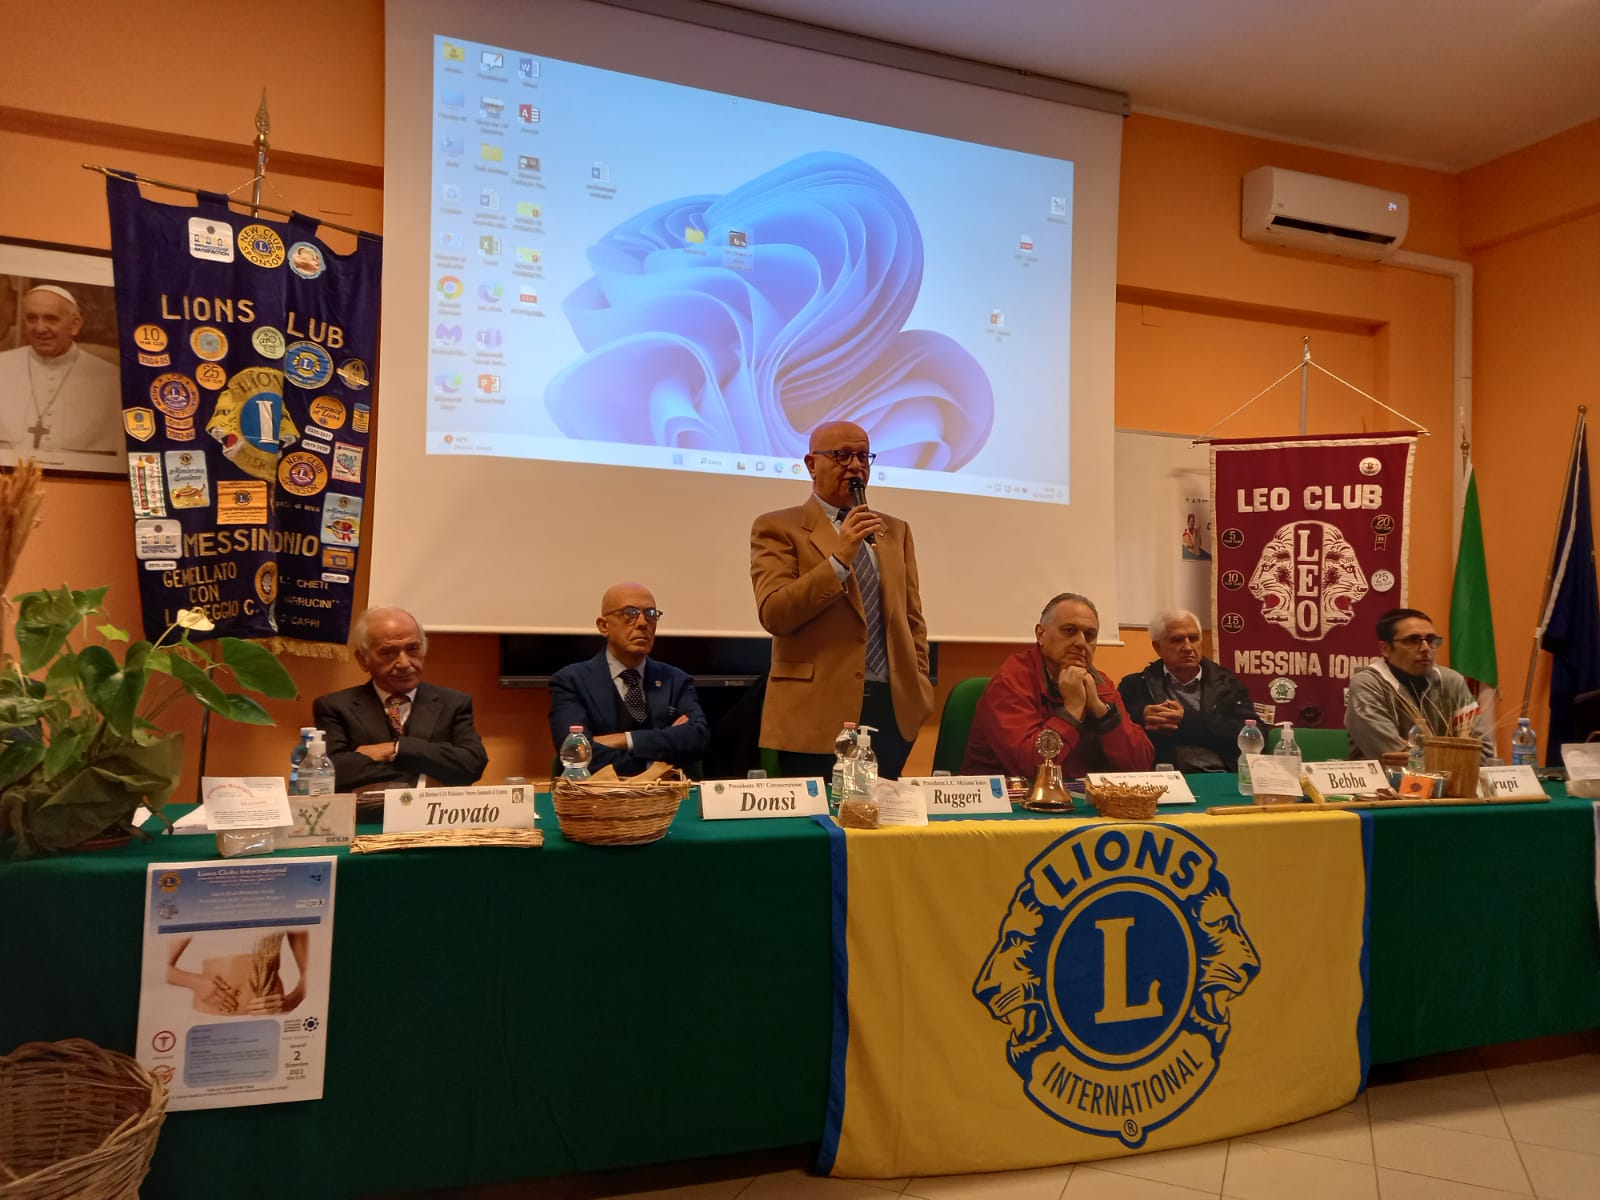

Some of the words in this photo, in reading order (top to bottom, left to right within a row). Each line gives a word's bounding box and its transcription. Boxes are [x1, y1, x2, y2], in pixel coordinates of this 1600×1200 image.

[240, 227, 258, 242] NEW
[263, 229, 283, 251] CLUB
[241, 246, 282, 266] SPONSOR
[161, 294, 256, 323] LIONS
[143, 327, 160, 341] 10
[203, 365, 219, 379] 25
[286, 455, 303, 465] NEW
[307, 456, 324, 474] CLUB
[1236, 487, 1291, 513] LEO
[1303, 484, 1383, 511] CLUB
[1229, 531, 1236, 540] 5
[163, 562, 237, 588] GEMELLATO
[1228, 573, 1239, 583] 10
[1297, 529, 1319, 633] LEO
[1375, 572, 1389, 582] 25
[189, 584, 220, 604] CON
[1227, 616, 1239, 625] 15
[1234, 650, 1323, 677] MESSINA
[1491, 776, 1520, 793] rupi
[740, 791, 797, 812] Donsì
[934, 789, 982, 808] Ruggeri
[426, 801, 500, 826] Trovato
[1042, 830, 1202, 899] LIONS
[1094, 916, 1163, 1025] L
[294, 1050, 301, 1061] 2
[1042, 1048, 1203, 1117] INTERNATIONAL
